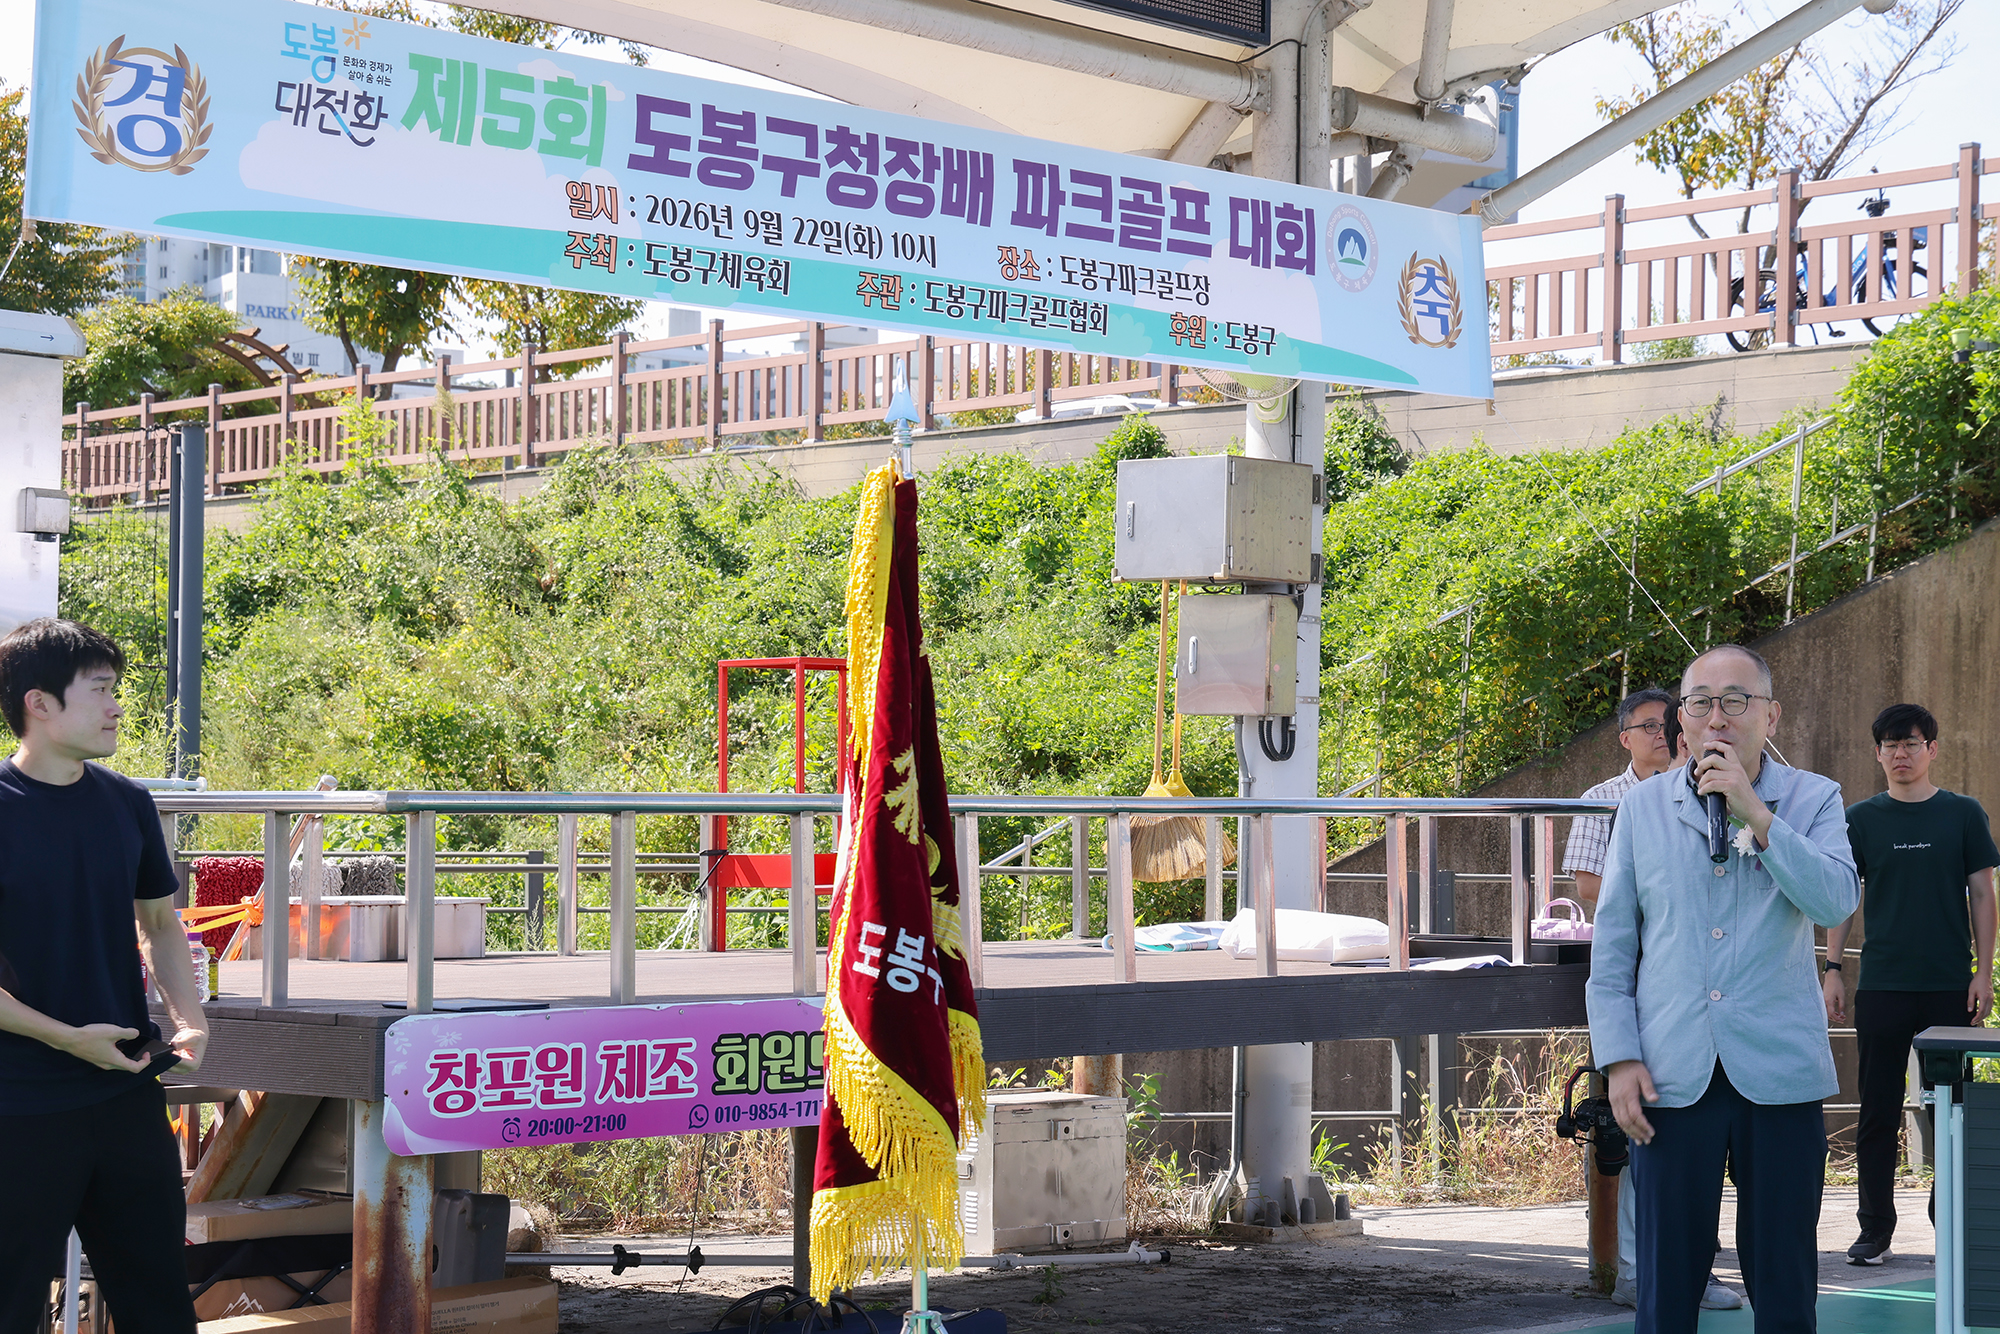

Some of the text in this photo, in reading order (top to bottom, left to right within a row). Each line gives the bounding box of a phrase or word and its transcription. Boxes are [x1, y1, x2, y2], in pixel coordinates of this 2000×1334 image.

[281, 22, 339, 84] 도봉
[343, 55, 393, 74] 문화와 경제가
[348, 70, 392, 87] 살아 숨 쉬는
[103, 58, 186, 157] 경
[275, 81, 389, 147] 대전환
[400, 52, 1316, 276] 제5회 도봉구청장배 파크골프 대회
[565, 180, 619, 224] 일시
[645, 194, 733, 240] 2026년
[743, 209, 783, 246] 9월
[792, 216, 883, 260] 22일(화)
[891, 231, 937, 269] 10시
[1341, 206, 1359, 217] Sports
[1360, 214, 1377, 245] Council
[564, 230, 618, 273] 주최
[643, 242, 790, 295] 도봉구체육회
[997, 246, 1041, 282] 장소
[1060, 255, 1210, 306] 도봉구파크골프장
[856, 270, 903, 311] 주관
[923, 280, 1108, 336] 도봉구파크골프협회
[1412, 265, 1450, 336] 축
[1169, 311, 1207, 349] 후원
[1224, 321, 1277, 356] 도봉구
[425, 1045, 584, 1116] 창포원
[597, 1040, 697, 1102] 체조
[527, 1114, 627, 1138] 20:00~21:00
[714, 1100, 824, 1124] 010-9854-171
